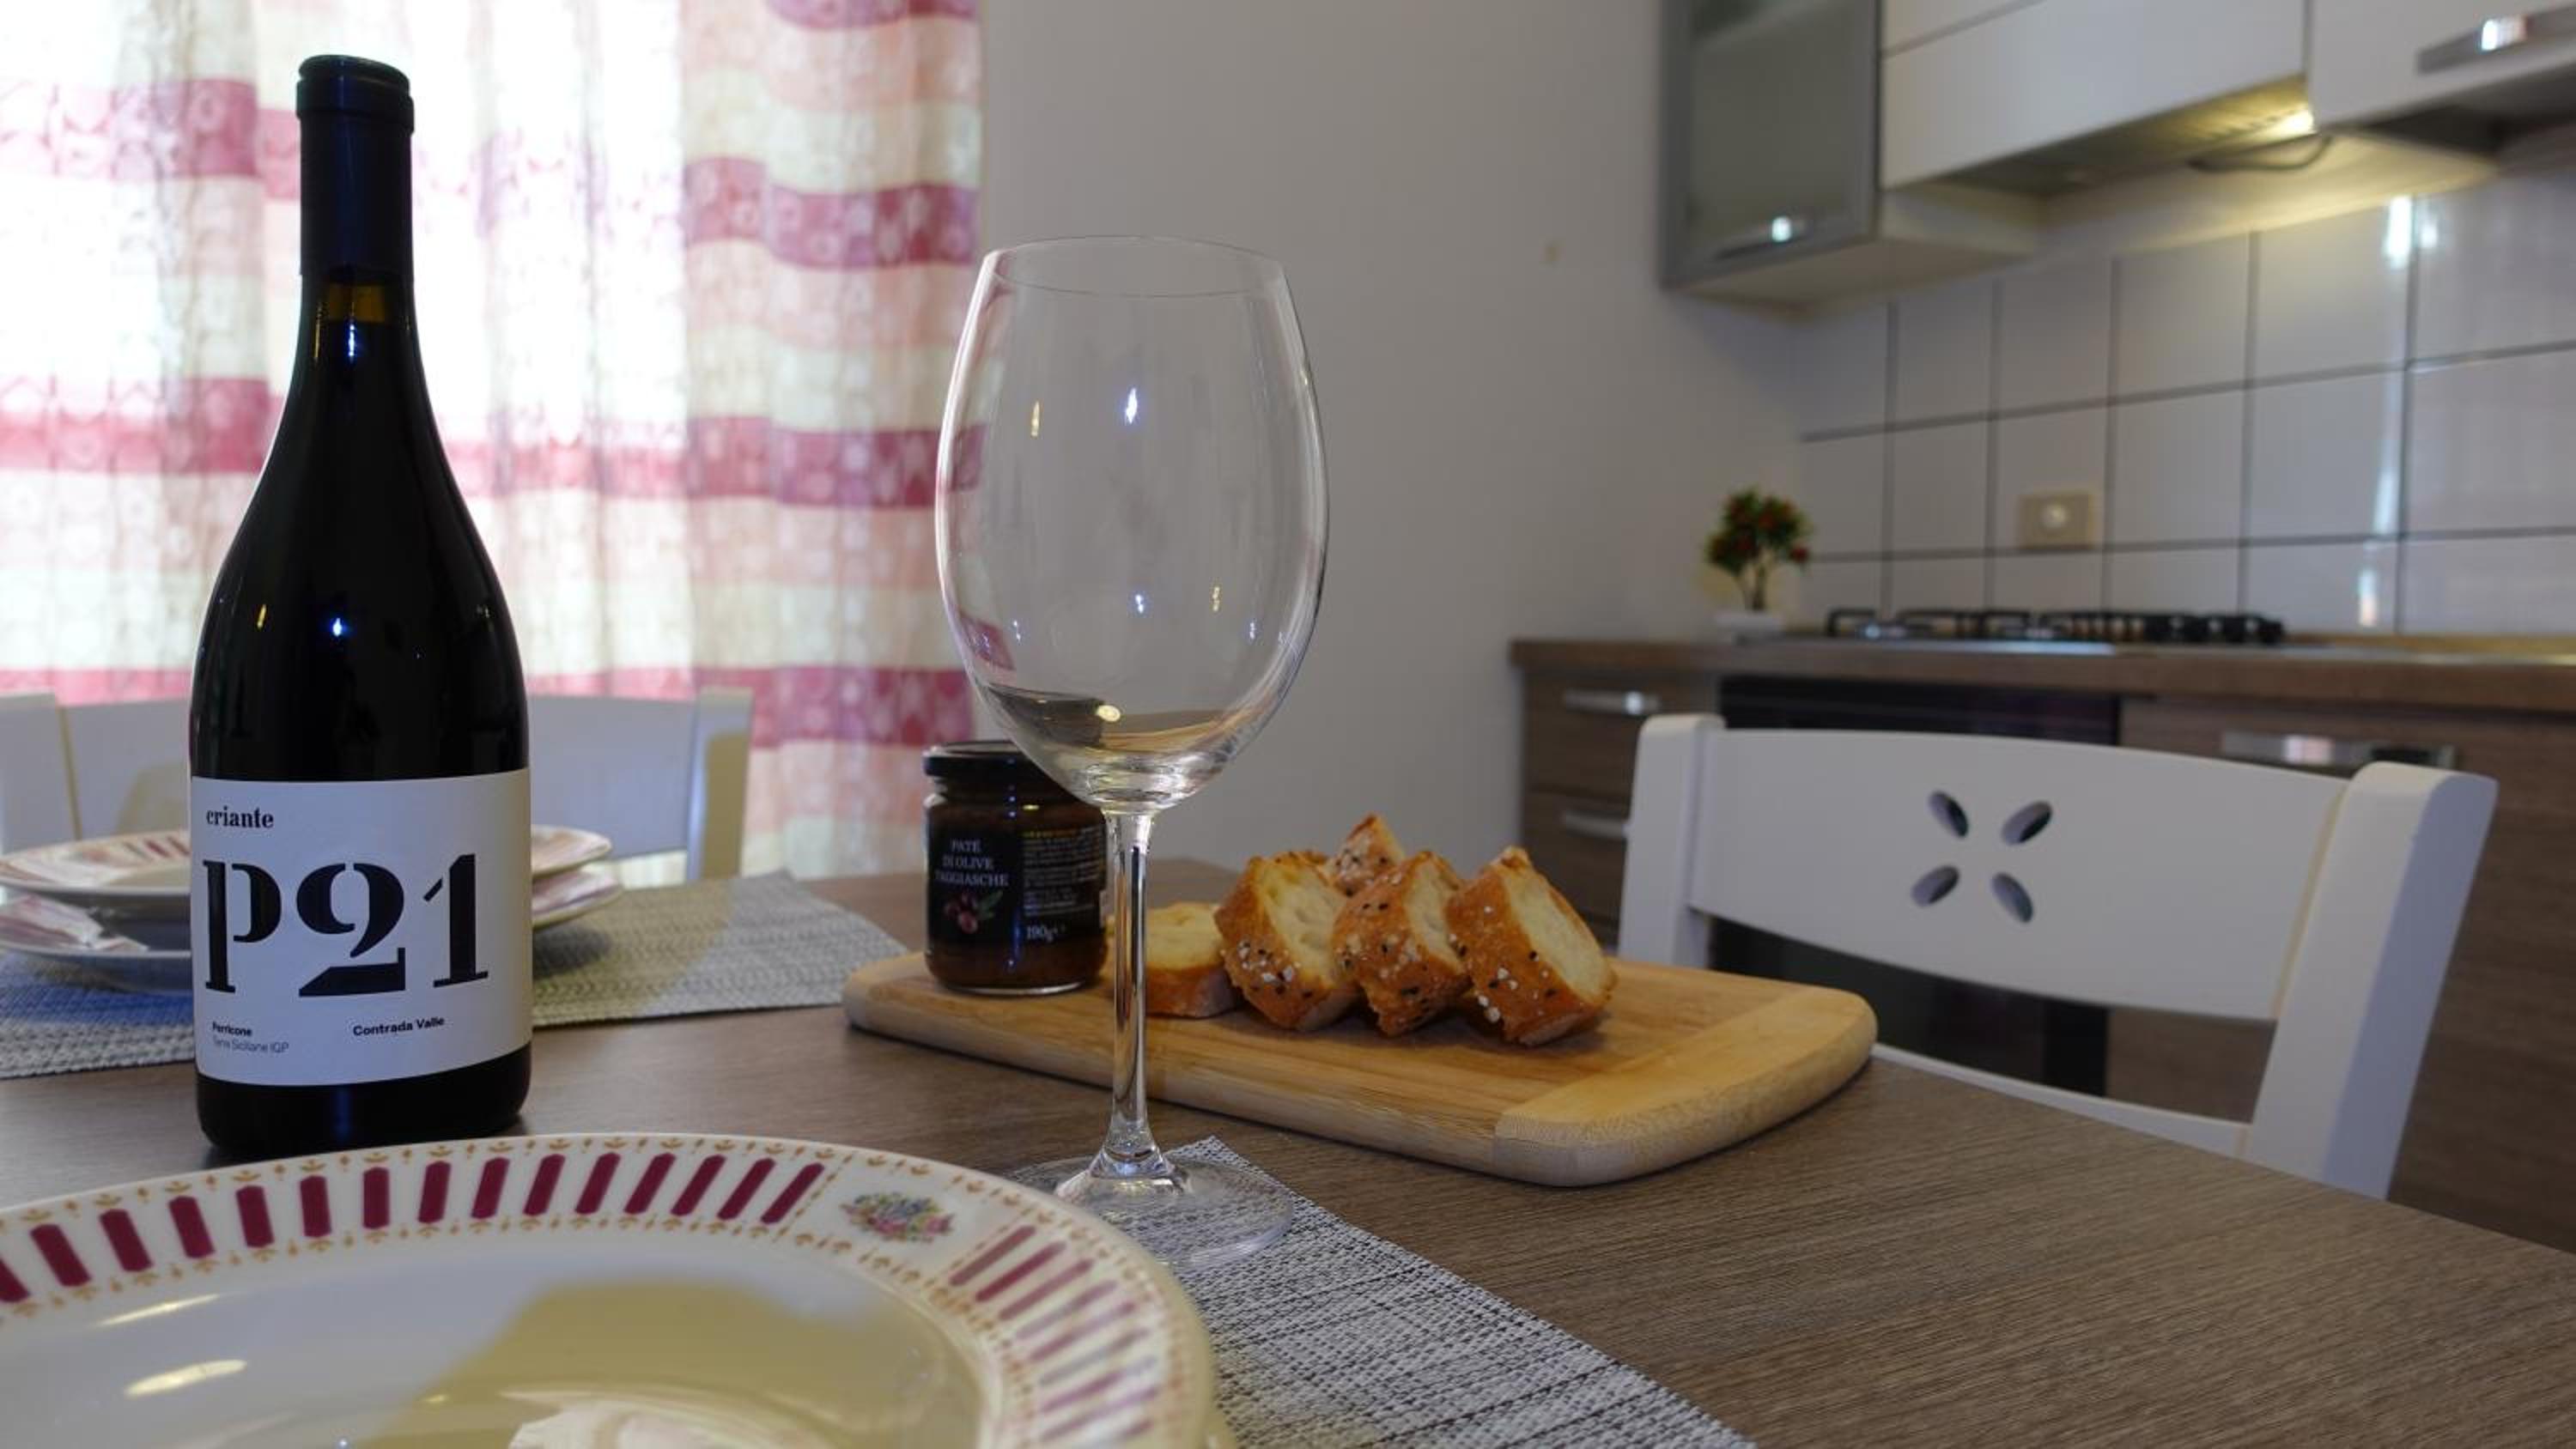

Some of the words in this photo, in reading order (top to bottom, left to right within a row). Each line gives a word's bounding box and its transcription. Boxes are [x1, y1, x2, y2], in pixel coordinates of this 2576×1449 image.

[206, 804, 274, 828] criante
[353, 1021, 413, 1036] Contrada
[416, 1016, 445, 1029] Valle
